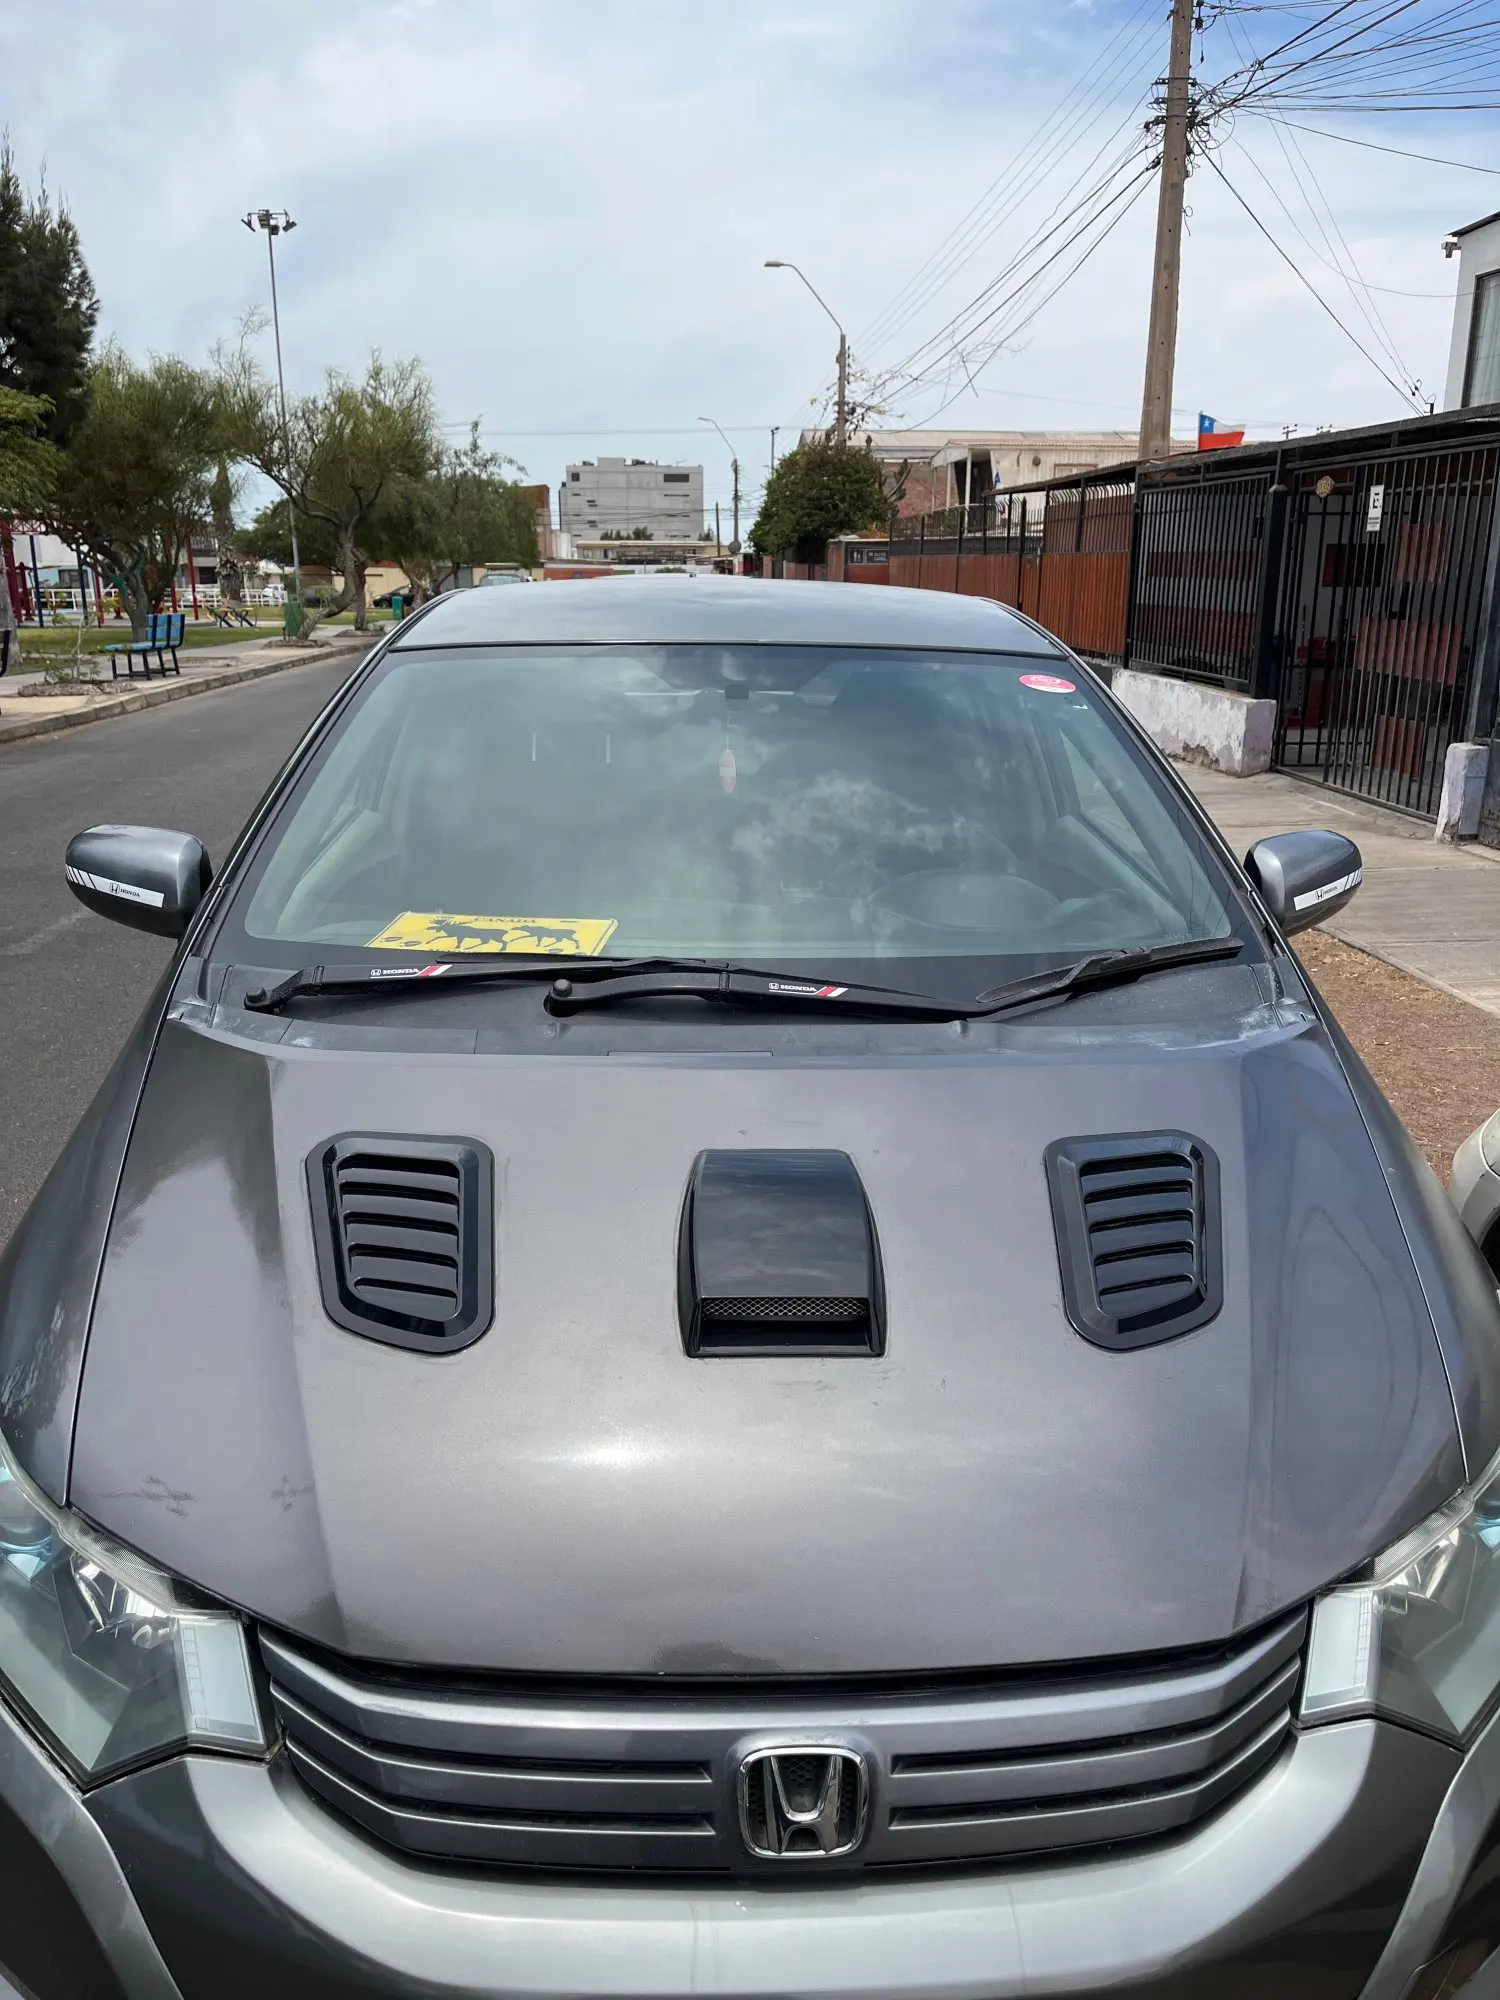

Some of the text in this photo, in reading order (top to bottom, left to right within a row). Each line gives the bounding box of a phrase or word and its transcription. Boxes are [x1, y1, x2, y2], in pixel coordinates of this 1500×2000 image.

[120, 888, 141, 898] HONDA
[474, 916, 536, 924] CANADA
[780, 984, 818, 992] HONDA
